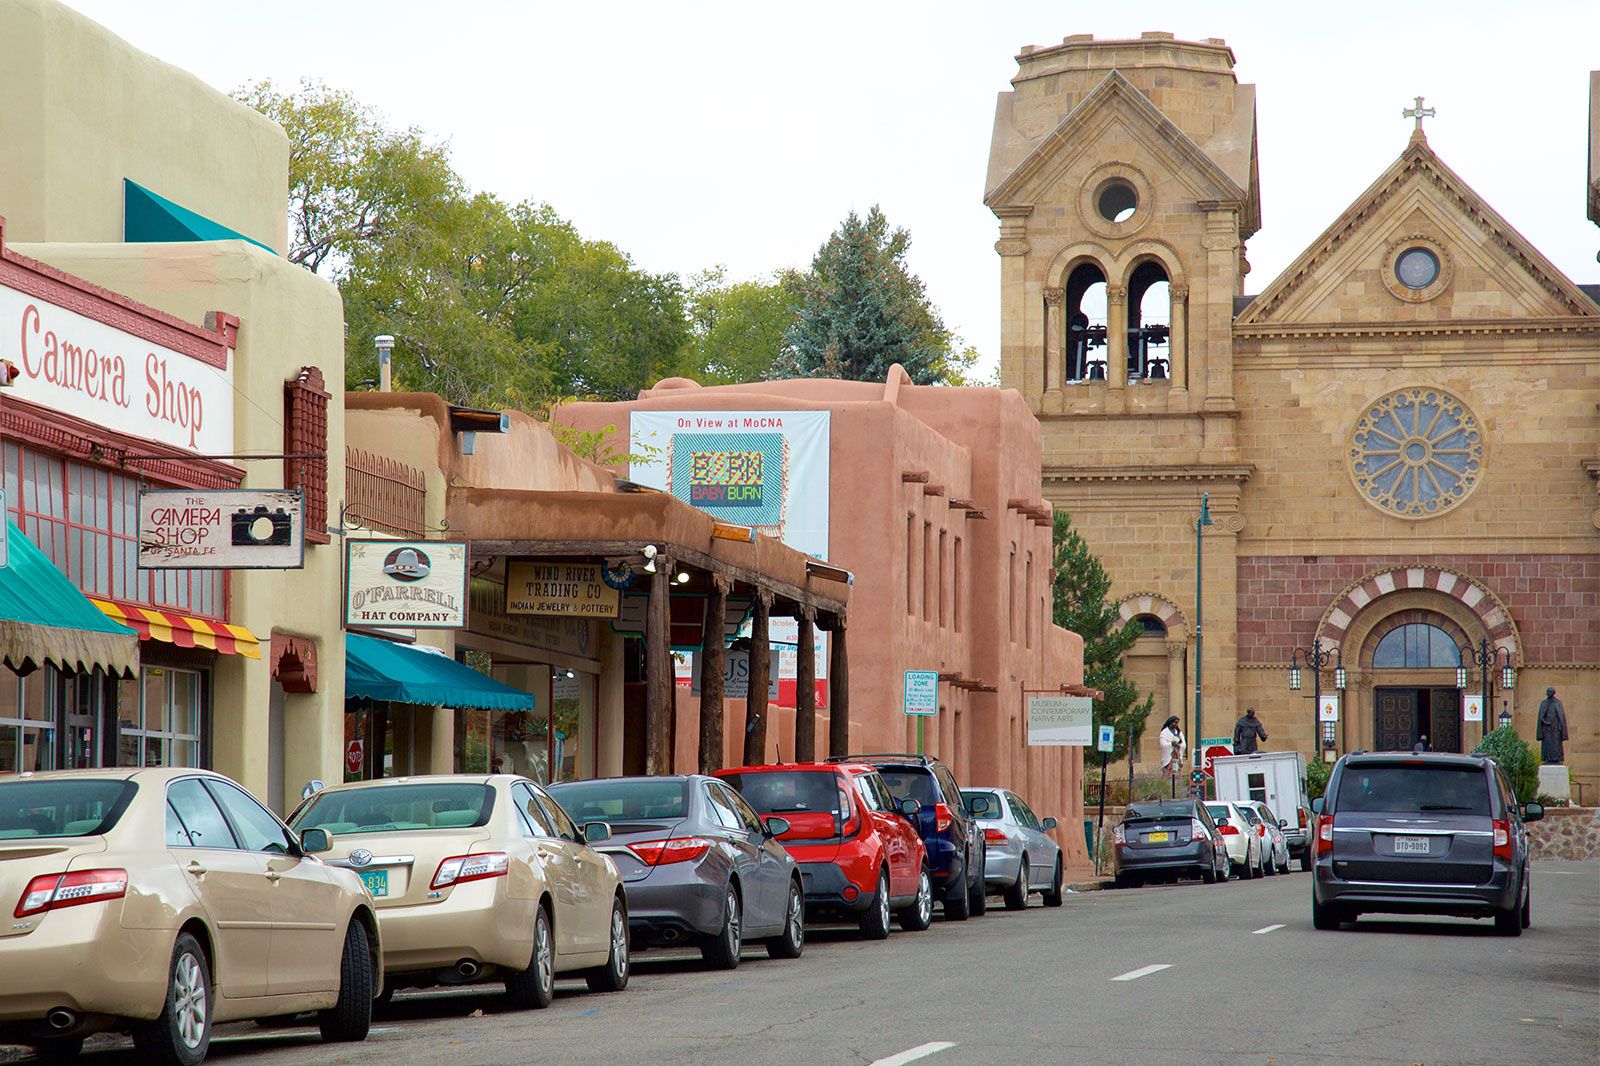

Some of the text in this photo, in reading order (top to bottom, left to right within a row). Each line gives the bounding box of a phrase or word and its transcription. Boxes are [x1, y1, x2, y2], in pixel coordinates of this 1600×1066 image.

[21, 304, 203, 449] Camera Shop
[677, 418, 783, 428] On View at MoCNA
[692, 486, 762, 500] BABY BURN
[185, 497, 204, 505] THE
[151, 508, 220, 526] CAMERA
[155, 527, 209, 544] SHOP
[168, 547, 198, 555] SANTA
[203, 546, 216, 554] FE
[534, 566, 595, 582] WIND RIVER
[526, 582, 601, 599] TRADING CO
[352, 585, 459, 612] O'FARRELL
[510, 601, 534, 610] INDIAN
[537, 602, 570, 612] JEWELRY
[581, 603, 614, 613] POTTERY
[361, 611, 449, 621] HAT COMPANY
[908, 673, 935, 681] LOADING
[1031, 707, 1090, 715] CONTEMPORARY
[368, 876, 386, 889] 834
